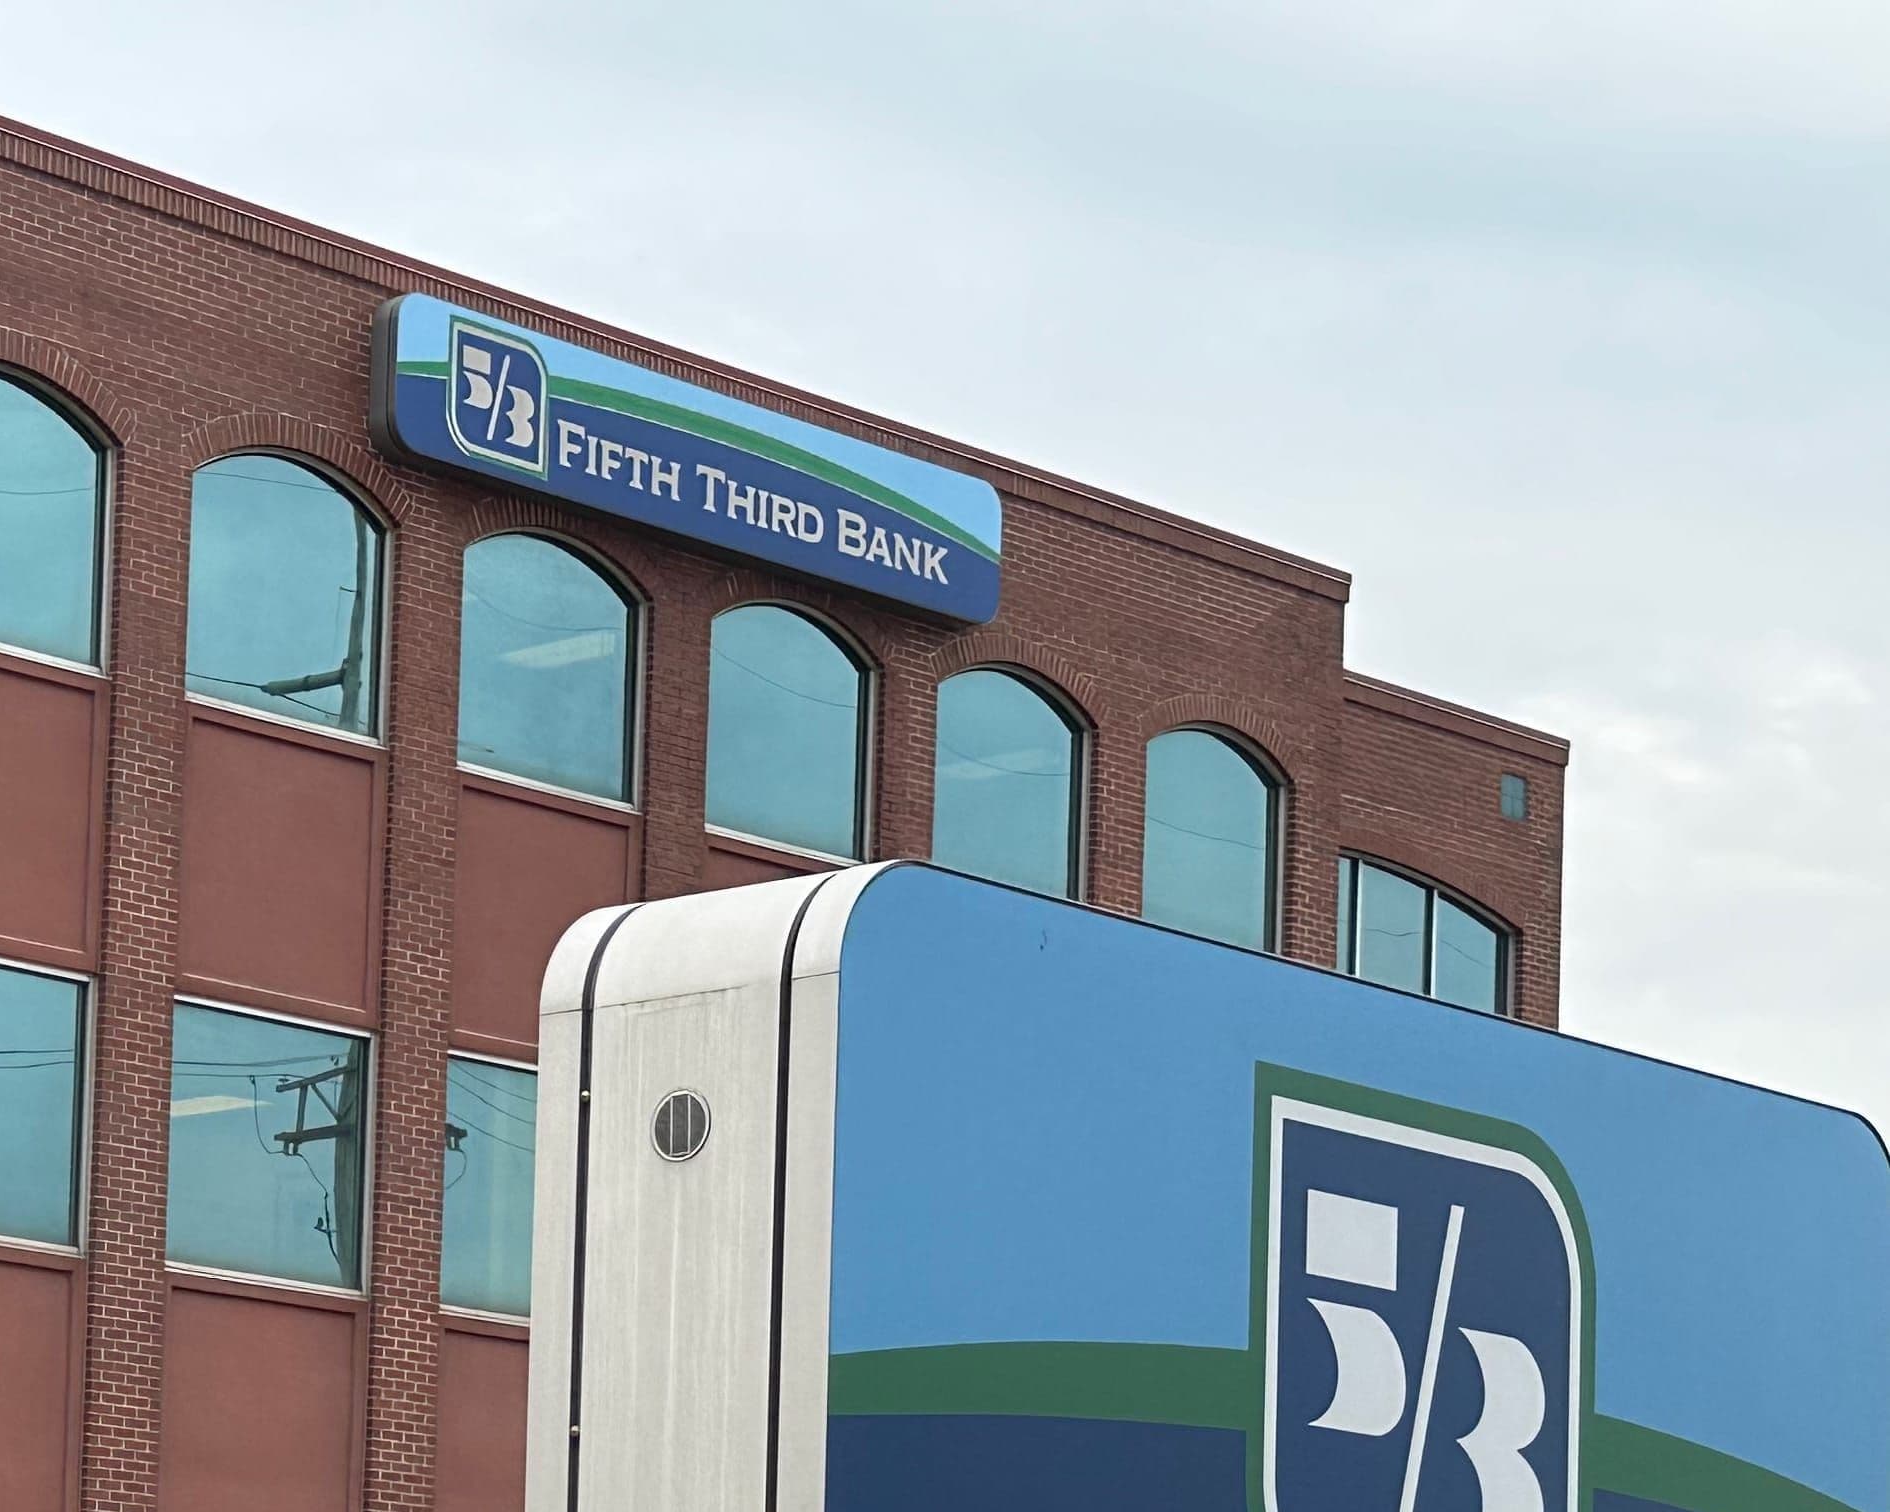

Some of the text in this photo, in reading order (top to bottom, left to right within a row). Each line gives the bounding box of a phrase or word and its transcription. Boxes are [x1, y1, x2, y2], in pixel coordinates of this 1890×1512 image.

[558, 419, 948, 584] FIFTH THIRD BANK
